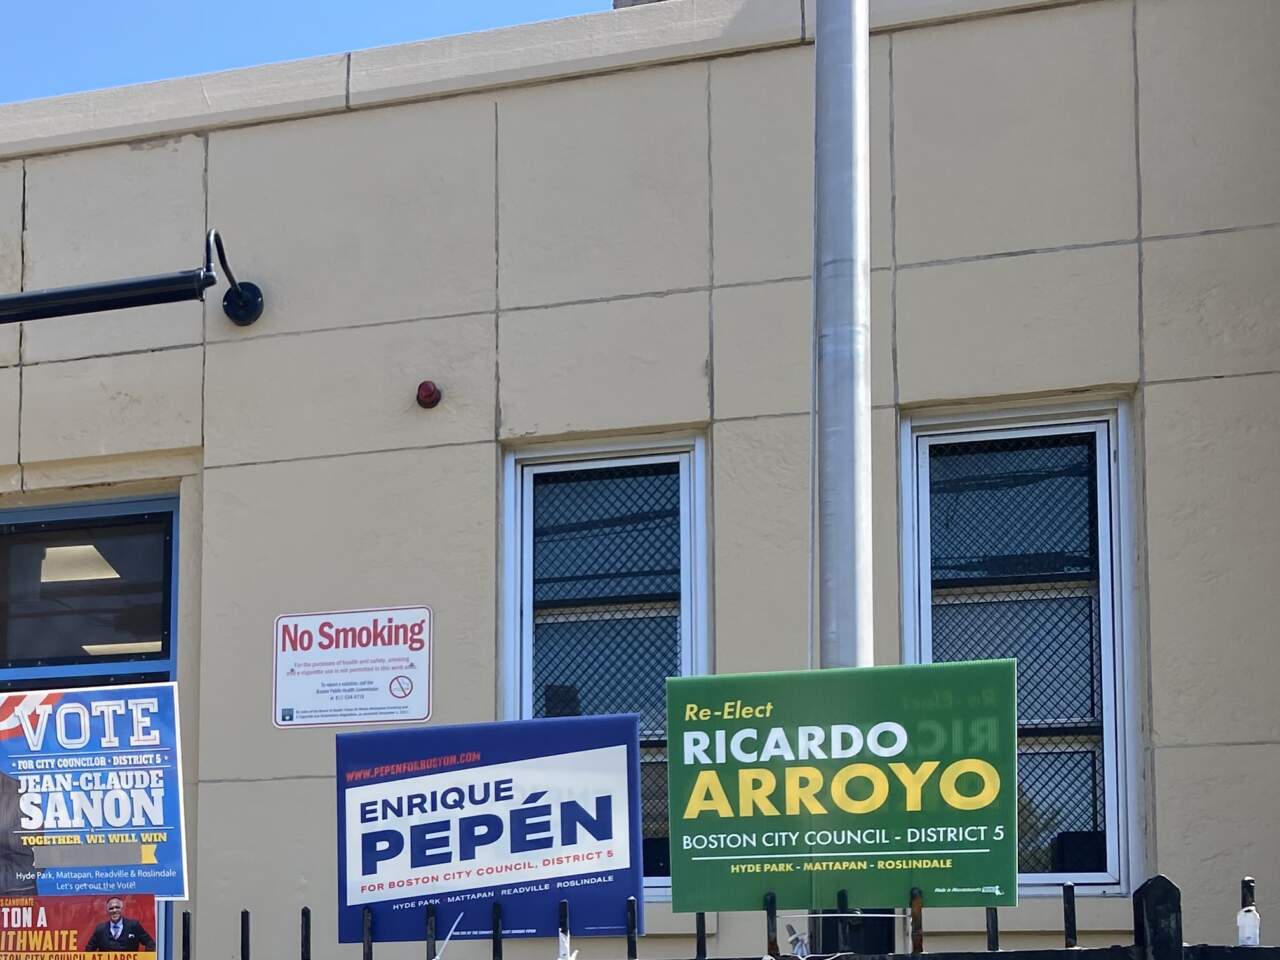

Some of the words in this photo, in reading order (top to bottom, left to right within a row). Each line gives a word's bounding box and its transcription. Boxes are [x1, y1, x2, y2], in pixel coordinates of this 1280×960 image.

[281, 623, 313, 652] No
[318, 618, 426, 651] Smoking
[14, 697, 161, 751] VOTE
[684, 700, 774, 722] Re-Elect
[683, 720, 909, 765] RICARDO
[17, 759, 34, 770] FOR
[35, 758, 56, 769] CITY
[57, 756, 106, 768] COUNCILOR
[112, 754, 155, 766] DISTRICT
[155, 753, 162, 764] 5
[345, 751, 482, 782] WWW.PEPENFORBOSTON.COM
[17, 770, 164, 794] JEAN-CLAUDE
[682, 758, 1001, 820] ARROYO
[19, 788, 166, 829] SANON
[360, 777, 515, 824] ENRIQUE
[85, 834, 106, 844] WE
[107, 833, 138, 844] WILL
[140, 832, 168, 843] WIN
[361, 790, 614, 877] PEPÉN
[682, 832, 757, 850] BOSTON
[761, 830, 800, 847] CITY
[804, 828, 890, 846] COUNCIL
[907, 825, 988, 843] DISTRICT
[992, 824, 1005, 841] 5
[15, 871, 36, 881] Hyde
[36, 870, 55, 880] Park,
[56, 870, 93, 881] Mattapan,
[94, 869, 130, 879] Readville
[130, 869, 137, 878] &
[137, 868, 177, 878] Roslindale
[360, 882, 385, 894] FOR
[388, 875, 440, 890] BOSTON
[443, 869, 472, 882] CITY
[476, 862, 538, 877] COUNCIL,
[542, 850, 604, 868] DISTRICT
[606, 849, 615, 859] 5
[730, 863, 762, 874] HYDE
[763, 862, 794, 873] PARK
[803, 860, 868, 872] MATTAPAN
[877, 858, 953, 870] ROSLINDALE
[56, 882, 73, 891] Let's
[74, 883, 87, 893] get
[87, 882, 101, 890] out
[102, 881, 116, 890] the
[116, 881, 136, 890] Vote!
[392, 900, 417, 911] HYDE
[417, 897, 441, 908] PARK
[446, 890, 495, 904] MATTAPAN
[500, 883, 551, 896] READVILLE
[556, 874, 615, 889] ROSLINDALE
[36, 906, 48, 928] A
